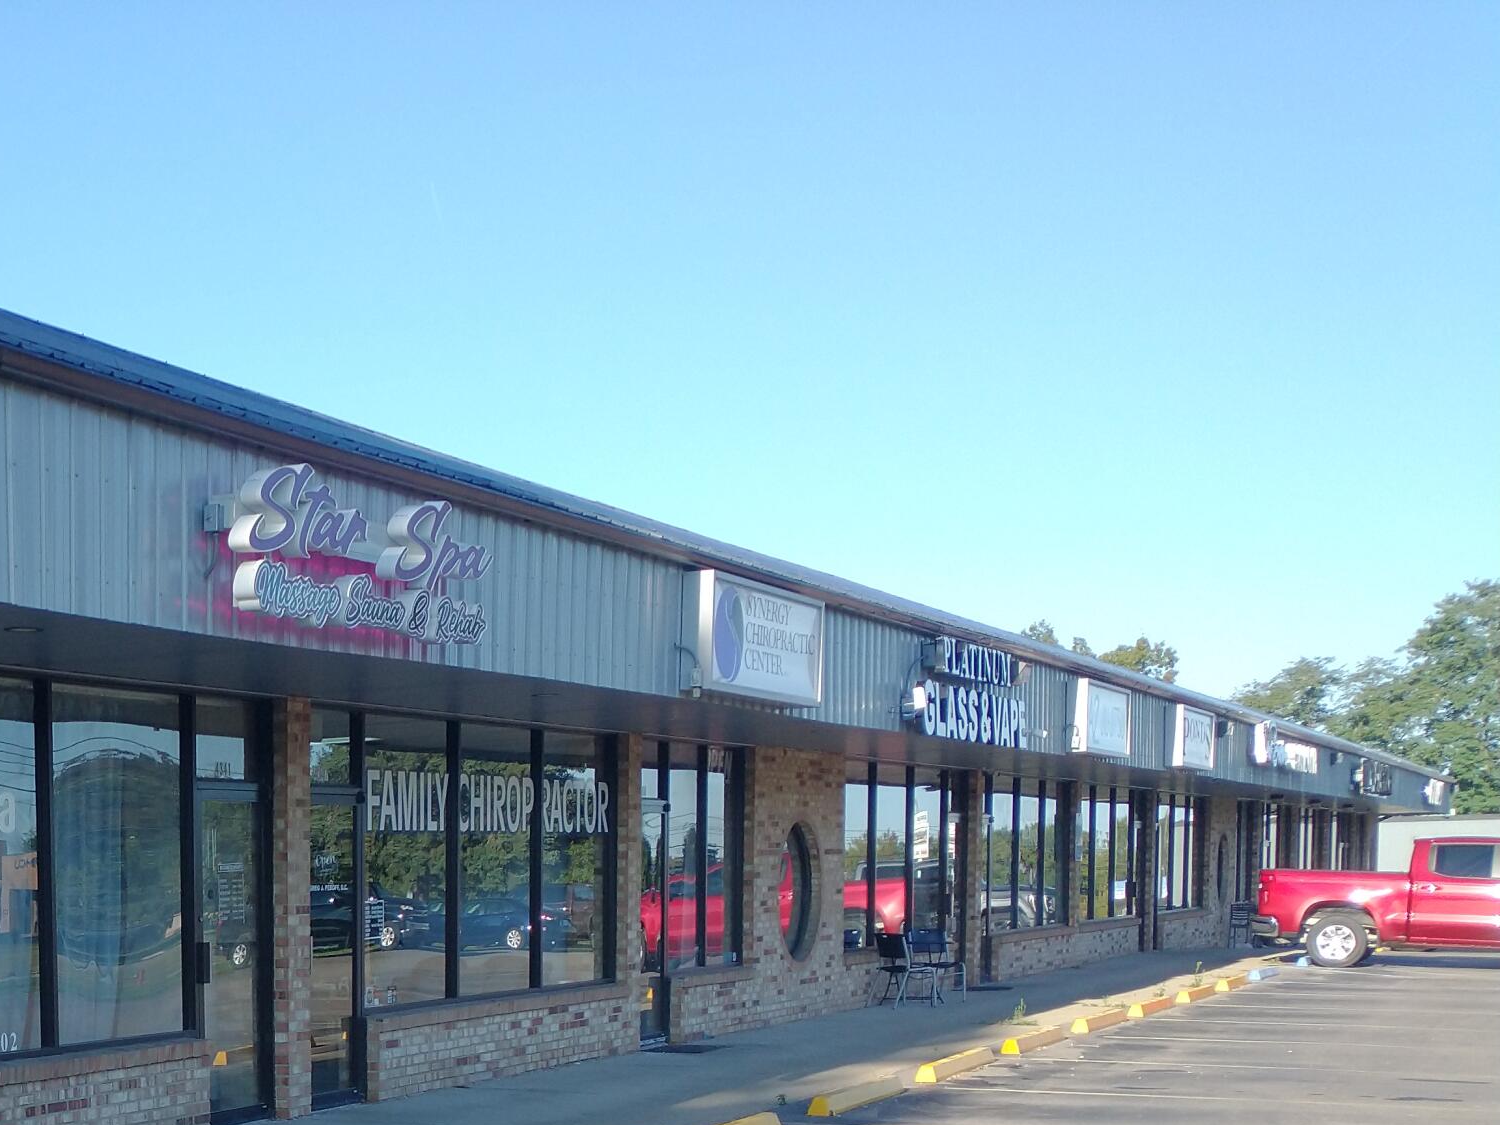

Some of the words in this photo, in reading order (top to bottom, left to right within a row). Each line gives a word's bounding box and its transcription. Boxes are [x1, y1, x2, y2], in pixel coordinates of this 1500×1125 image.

[249, 463, 367, 558] Star
[394, 500, 492, 598] Spa
[254, 560, 340, 627] Massage
[345, 575, 404, 627] Sauna
[408, 590, 430, 638] &
[436, 597, 487, 644] Rehab
[746, 594, 792, 625] SYNERGY
[744, 647, 784, 676] CENTER
[745, 621, 816, 656] CHIROPRACTIC
[943, 636, 1012, 687] PLATINUM
[367, 769, 449, 832] FAMILY
